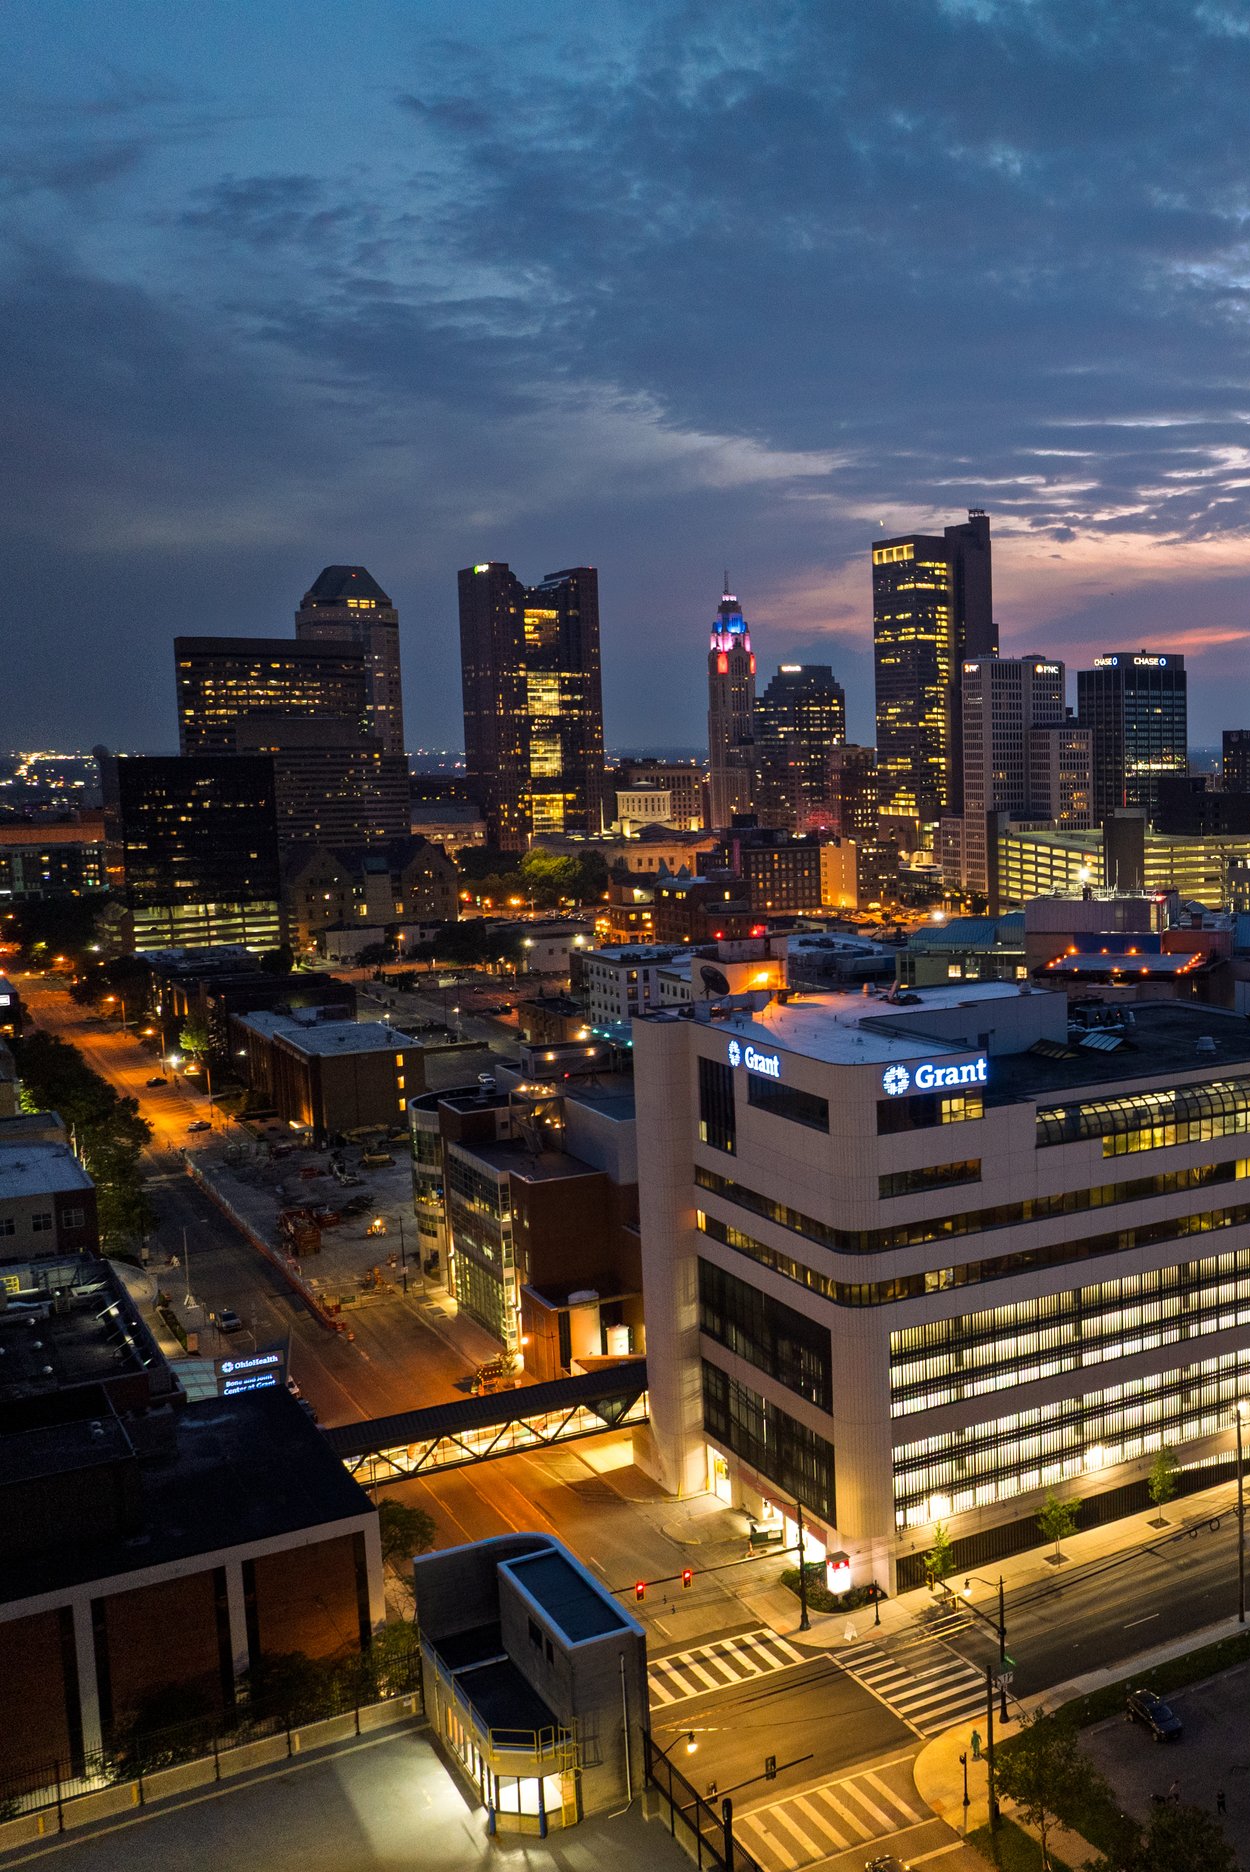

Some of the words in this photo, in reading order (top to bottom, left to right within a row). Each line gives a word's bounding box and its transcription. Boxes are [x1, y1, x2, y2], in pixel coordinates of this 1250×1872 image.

[1094, 658, 1112, 666] CHASE
[1134, 657, 1159, 666] CHASE
[1043, 665, 1059, 673] PNC
[744, 1046, 780, 1078] Grant
[915, 1058, 987, 1089] Grant
[234, 1355, 279, 1369] OhioHealth
[223, 1386, 247, 1396] Center
